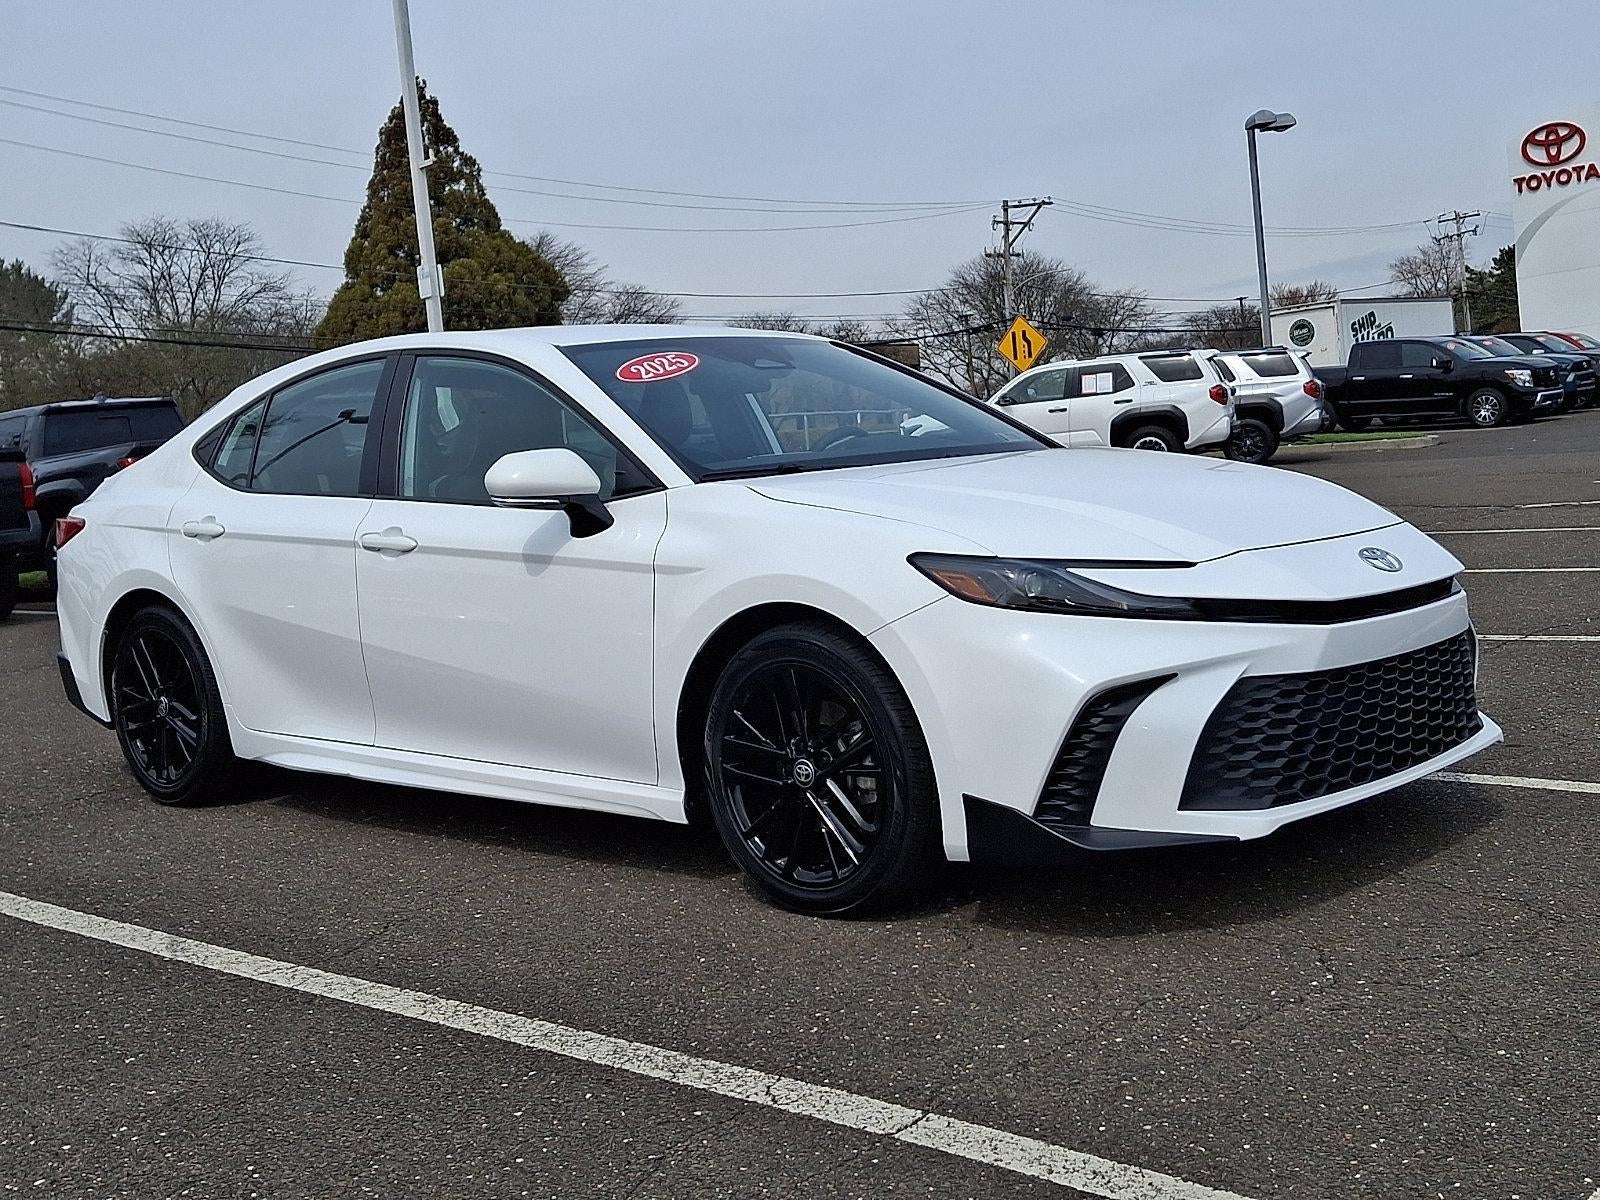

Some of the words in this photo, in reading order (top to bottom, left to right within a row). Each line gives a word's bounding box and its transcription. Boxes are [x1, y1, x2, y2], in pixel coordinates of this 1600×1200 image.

[1512, 163, 1600, 194] TOYOTA
[1350, 310, 1377, 338] SHIP
[630, 354, 689, 379] 2025
